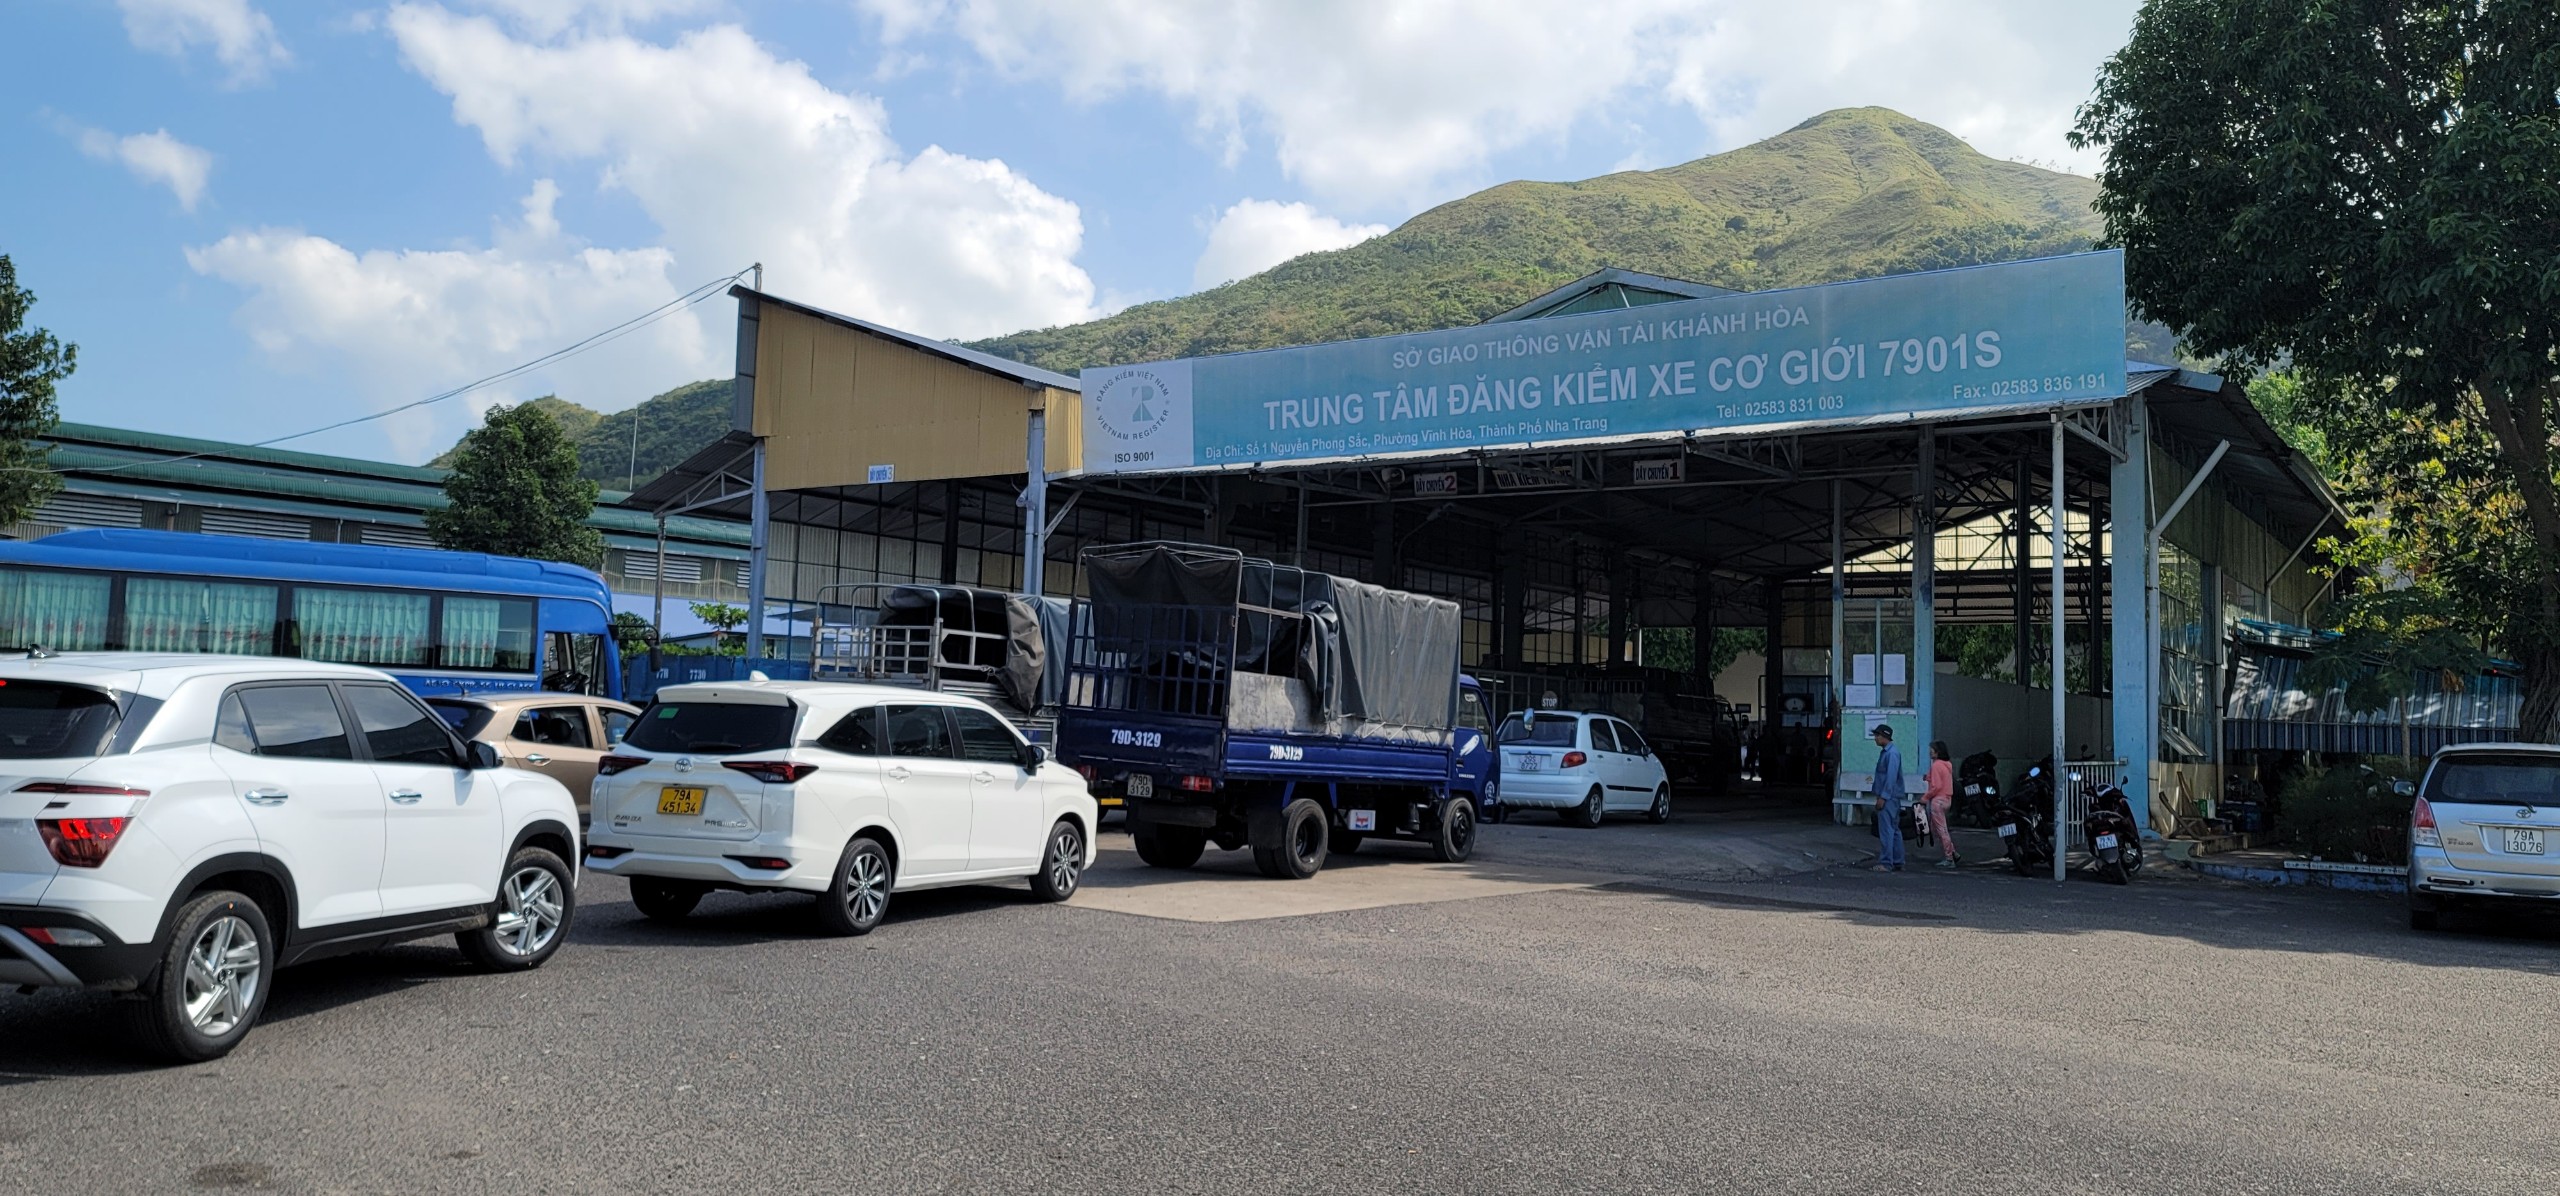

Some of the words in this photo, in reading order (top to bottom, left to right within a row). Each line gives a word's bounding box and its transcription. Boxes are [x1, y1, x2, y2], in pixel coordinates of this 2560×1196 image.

[1393, 346, 1422, 369] SỞ
[1428, 344, 1479, 366] GIAO
[1484, 335, 1559, 359] THÔNG
[1565, 329, 1611, 354] VẬN
[1618, 321, 1654, 345] TẢI
[1662, 313, 1746, 340] KHÁNH
[1755, 305, 1810, 330] HÒA
[1154, 377, 1169, 396] NAM
[1263, 393, 1364, 431] TRUNG
[1373, 382, 1437, 422] TÂM
[1447, 374, 1541, 415] ĐĂNG
[1553, 362, 1637, 407] KIỂM
[1648, 361, 1696, 398] XE
[1708, 353, 1768, 392] CƠ
[1780, 337, 1865, 385] GIỚI
[1879, 330, 2002, 376] 7901S
[1953, 384, 1986, 400] Fax:
[1991, 378, 2039, 396] 02583
[2043, 375, 2072, 392] 836
[2078, 372, 2106, 390] 191
[1716, 403, 1740, 419] Tel:
[1745, 400, 1785, 416] 02583
[1789, 397, 1813, 413] 831
[1819, 395, 1844, 410] 003
[1097, 415, 1129, 440] VIETNAM
[1132, 409, 1169, 440] REGISTER
[1246, 440, 1259, 455] Số
[1262, 442, 1267, 454] 1
[1312, 438, 1345, 452] Phong
[1348, 433, 1371, 447] Sắc,
[1374, 432, 1418, 446] Phường
[1421, 428, 1446, 442] Vĩnh
[1450, 427, 1475, 441] Hòa,
[1479, 424, 1515, 438] Thành
[1519, 418, 1542, 435] Phố
[1545, 418, 1569, 433] Nha
[1572, 417, 1607, 433] Trang
[1114, 452, 1131, 463] ISO
[1133, 450, 1154, 462] 9001
[1670, 462, 1680, 480] 1
[1445, 475, 1456, 492] 2
[1542, 698, 1557, 707] STOP
[1111, 729, 1161, 748] 79D-3129
[1269, 744, 1303, 761] 79D-3129
[1133, 775, 1148, 786] 79D
[673, 789, 691, 800] 79A
[1130, 785, 1150, 796] 3129
[663, 802, 696, 814] 451.34
[2513, 830, 2535, 841] 79A
[2506, 840, 2543, 853] 130.76
